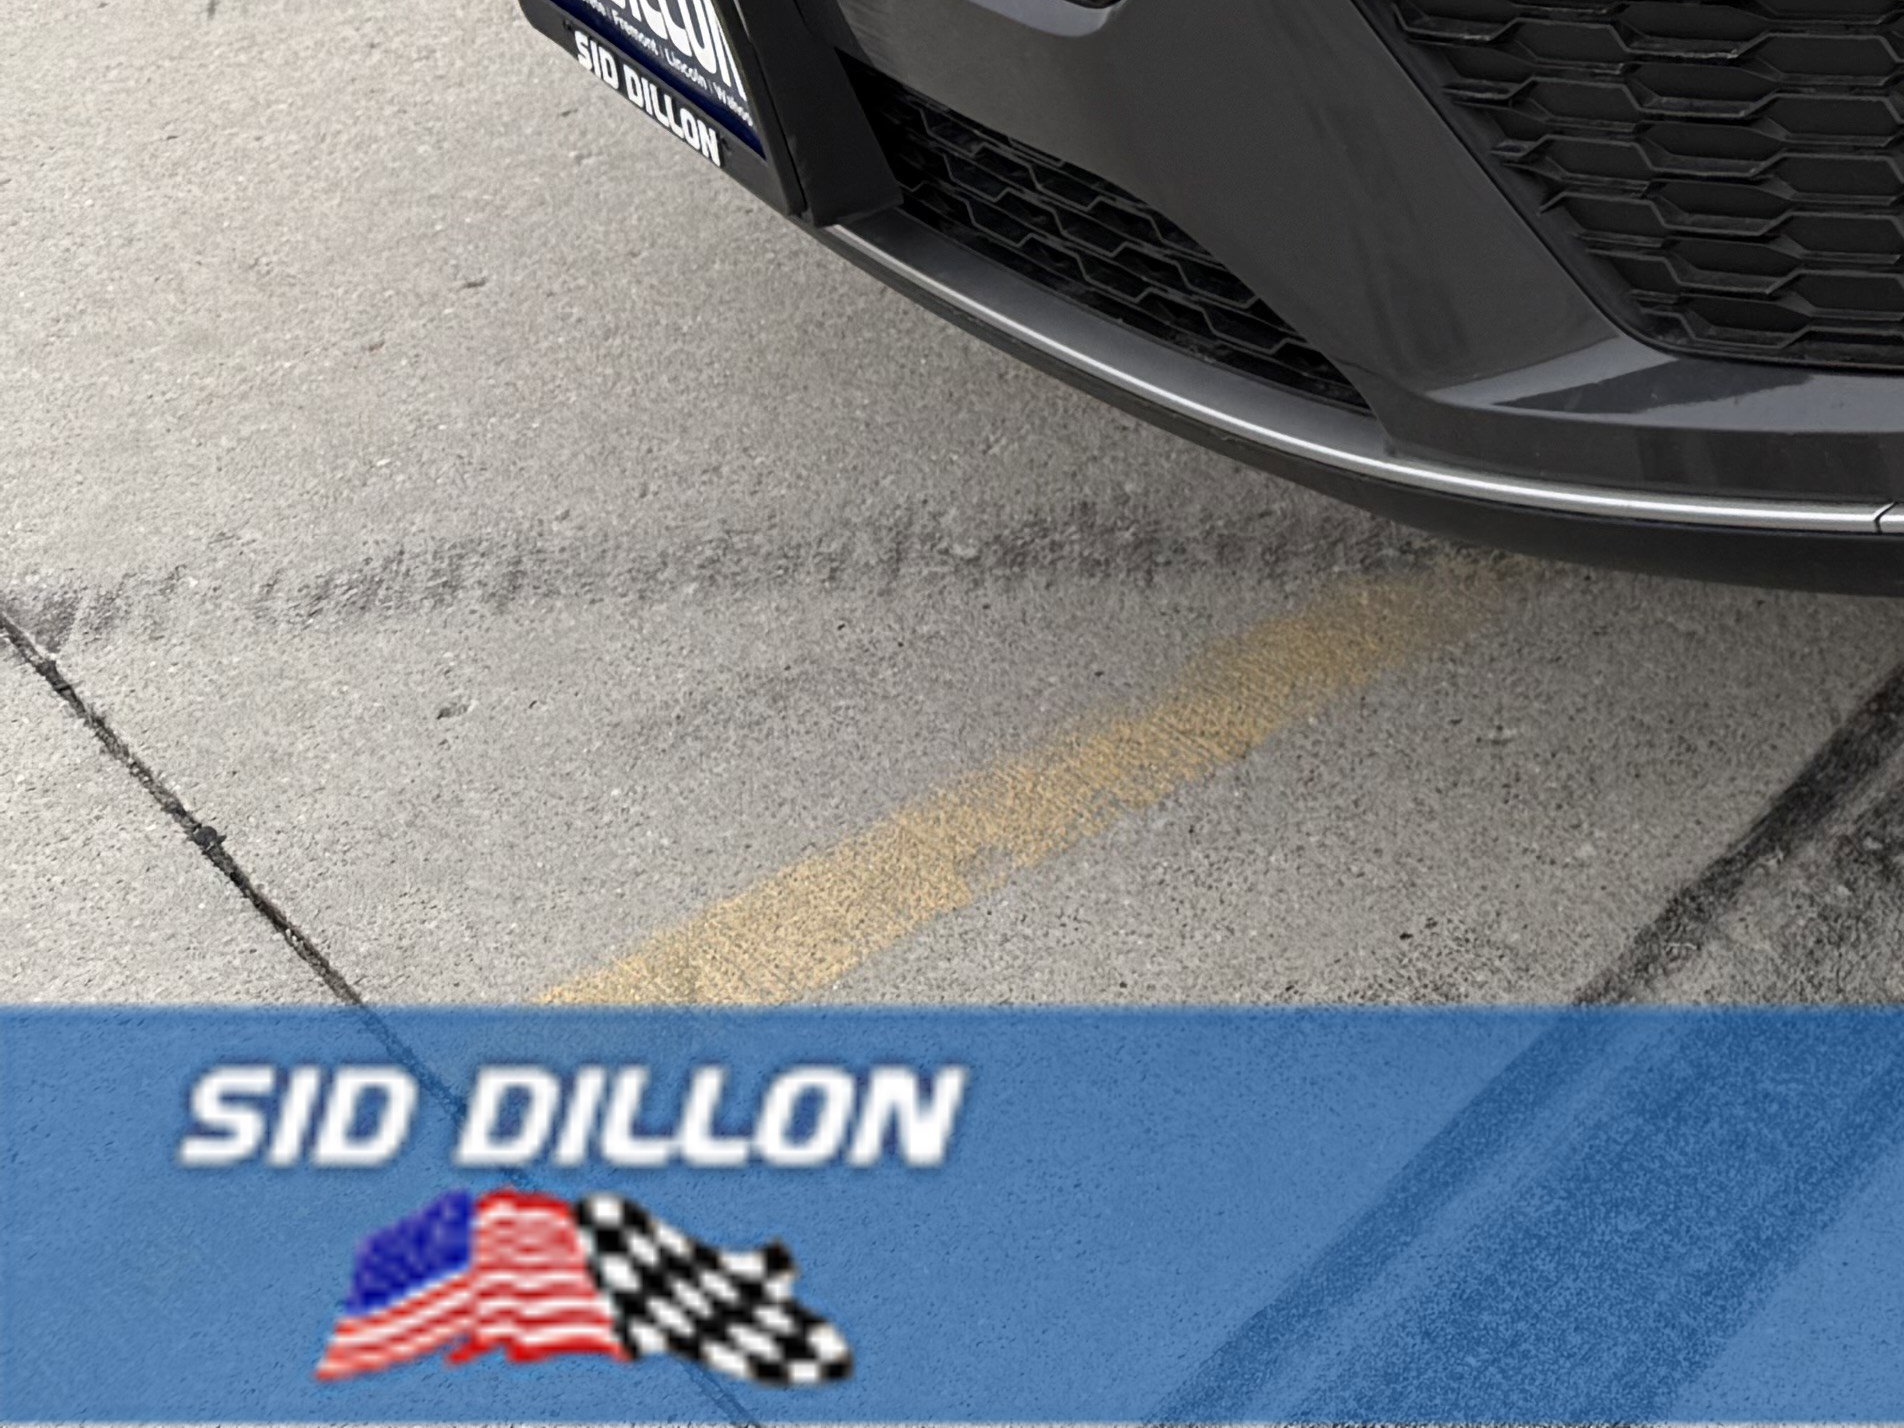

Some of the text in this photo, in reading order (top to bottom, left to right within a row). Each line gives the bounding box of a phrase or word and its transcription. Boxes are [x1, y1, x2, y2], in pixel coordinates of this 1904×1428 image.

[574, 30, 722, 168] SID DILLON
[611, 10, 660, 56] Fremont
[666, 50, 708, 91] Lincoln
